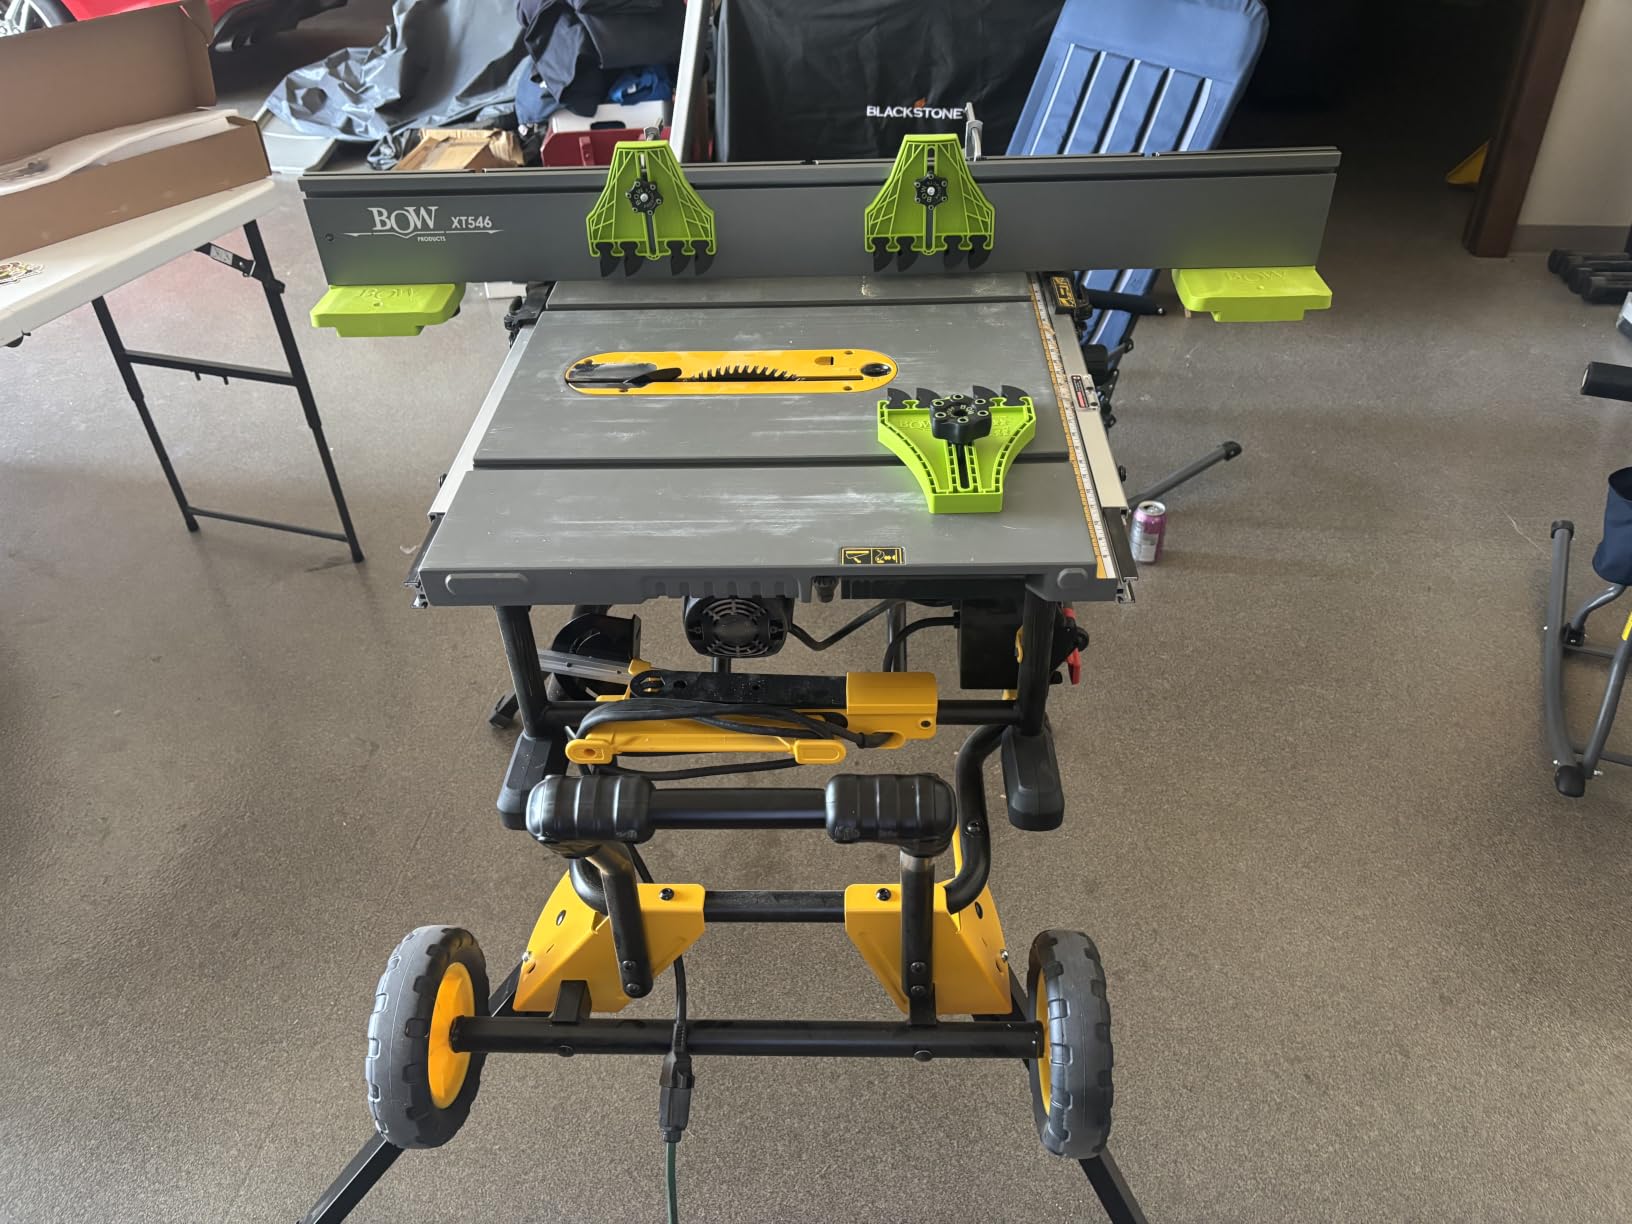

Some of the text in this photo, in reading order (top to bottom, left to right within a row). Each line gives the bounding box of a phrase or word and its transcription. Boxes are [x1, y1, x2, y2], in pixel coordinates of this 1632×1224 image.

[866, 105, 963, 120] BLACKSTONE
[367, 206, 493, 234] BOW XT546
